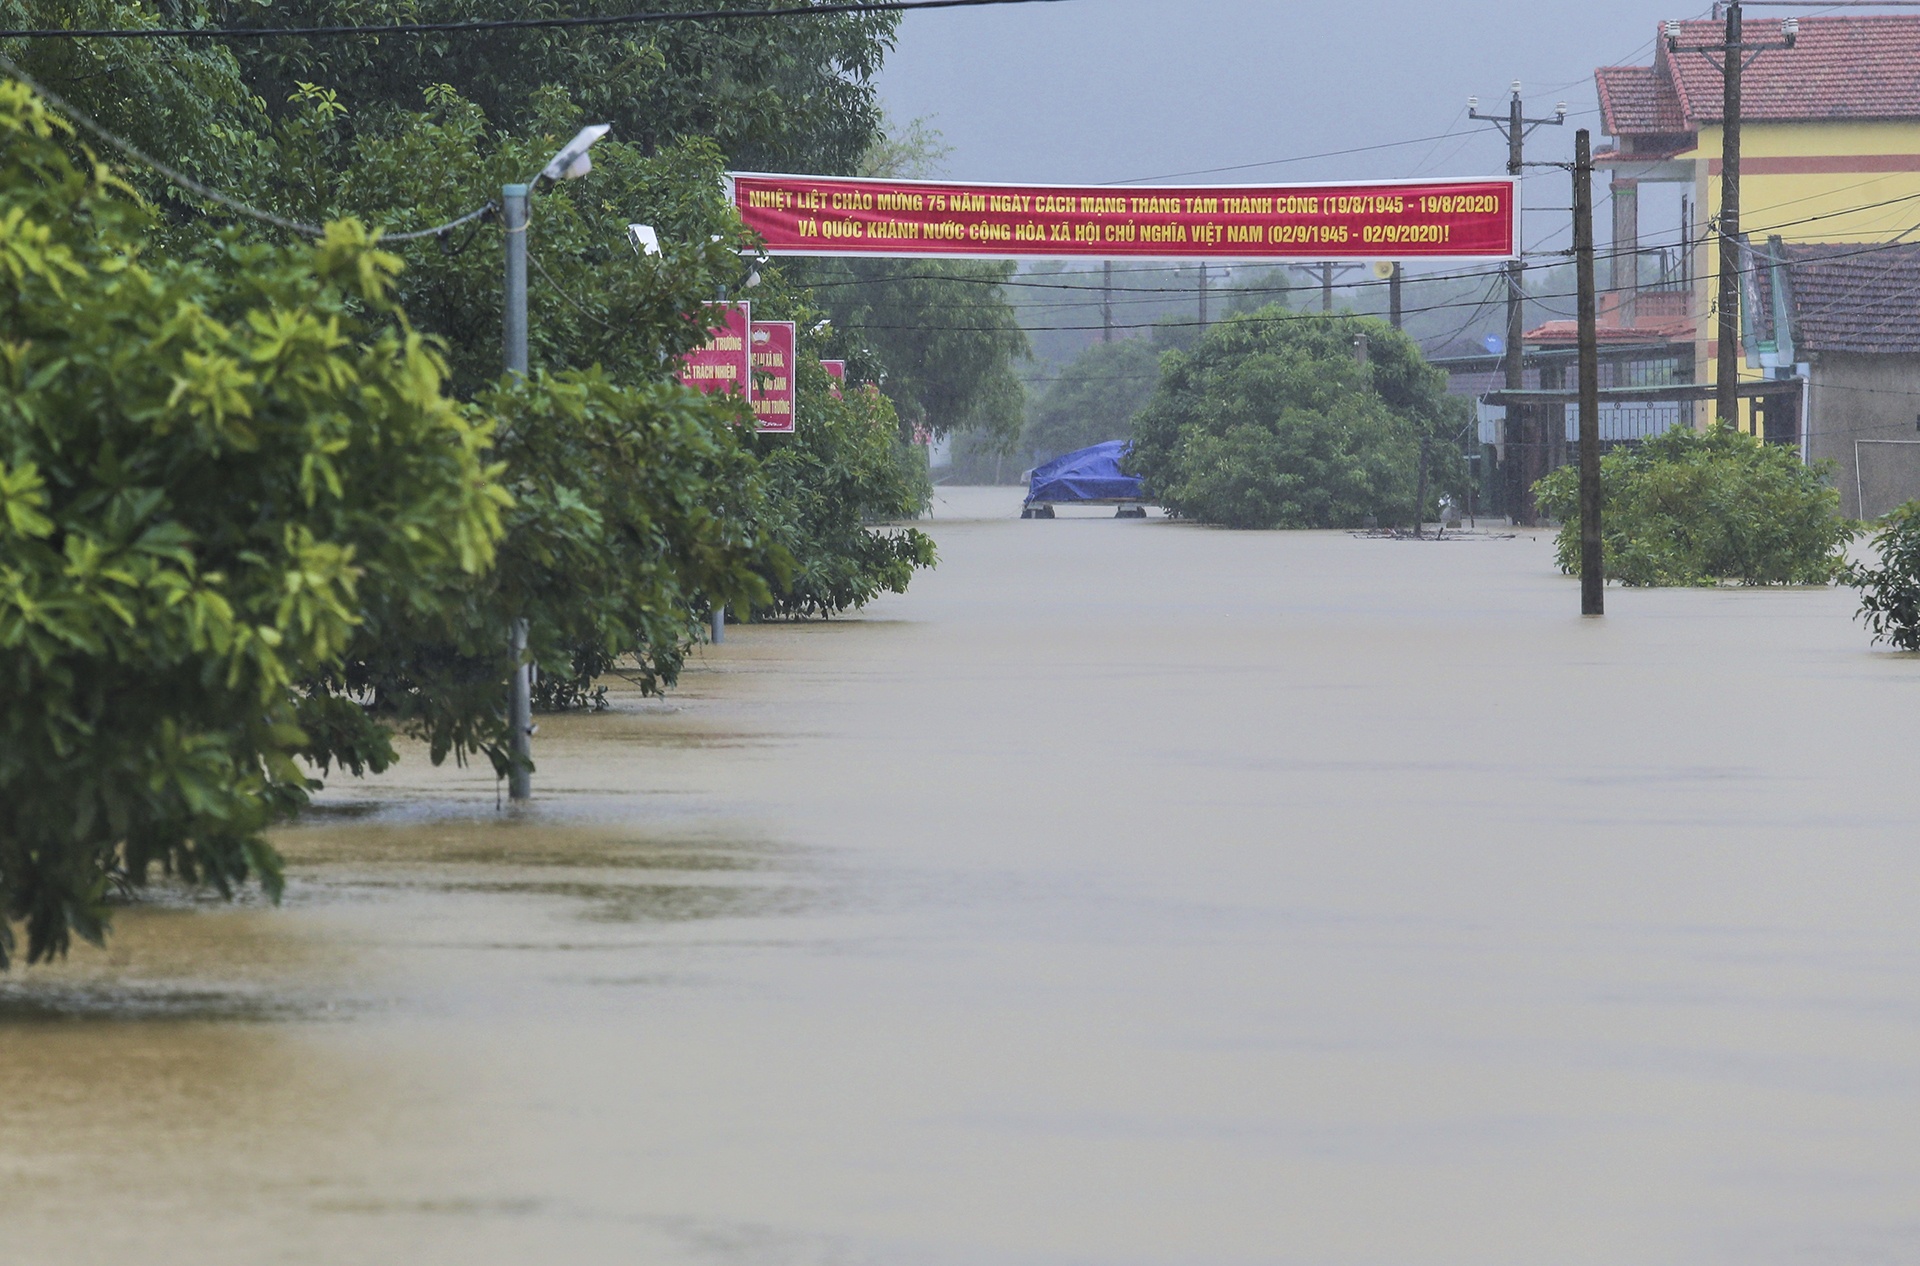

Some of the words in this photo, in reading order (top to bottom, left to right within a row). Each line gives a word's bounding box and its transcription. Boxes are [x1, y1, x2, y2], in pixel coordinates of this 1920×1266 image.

[749, 188, 793, 211] NHIỆT
[797, 189, 828, 212] LIỆT
[832, 190, 873, 210] CHÀO
[877, 191, 923, 211] MỪNG
[927, 195, 946, 211] 75
[950, 192, 986, 211] NĂM
[990, 194, 1031, 212] NGÀY
[1035, 195, 1076, 212] CÁCH
[1080, 197, 1126, 216] MẠNG
[1130, 196, 1180, 213] THÁNG
[1185, 196, 1218, 213] TÁM
[1222, 196, 1272, 213] THÀNH
[1276, 195, 1318, 213] CÔNG
[1323, 196, 1404, 215] (19/8/1945
[1419, 195, 1499, 214] 19/8/2020)
[798, 217, 818, 237] VÀ
[822, 215, 862, 239] QUỐC
[867, 219, 918, 239] KHÁNH
[923, 219, 964, 240] NƯỚC
[969, 221, 1011, 243] CỘNG
[1015, 221, 1046, 241] HÒA
[1050, 221, 1071, 241] XÃ
[1075, 221, 1100, 245] HỘI
[1105, 219, 1135, 242] CHỦ
[1140, 222, 1187, 242] NGHĨA
[1191, 221, 1223, 246] VIỆT
[1227, 225, 1263, 242] NAM
[1268, 225, 1348, 244] (02/9/1945
[1362, 225, 1450, 244] 02/9/2020)!
